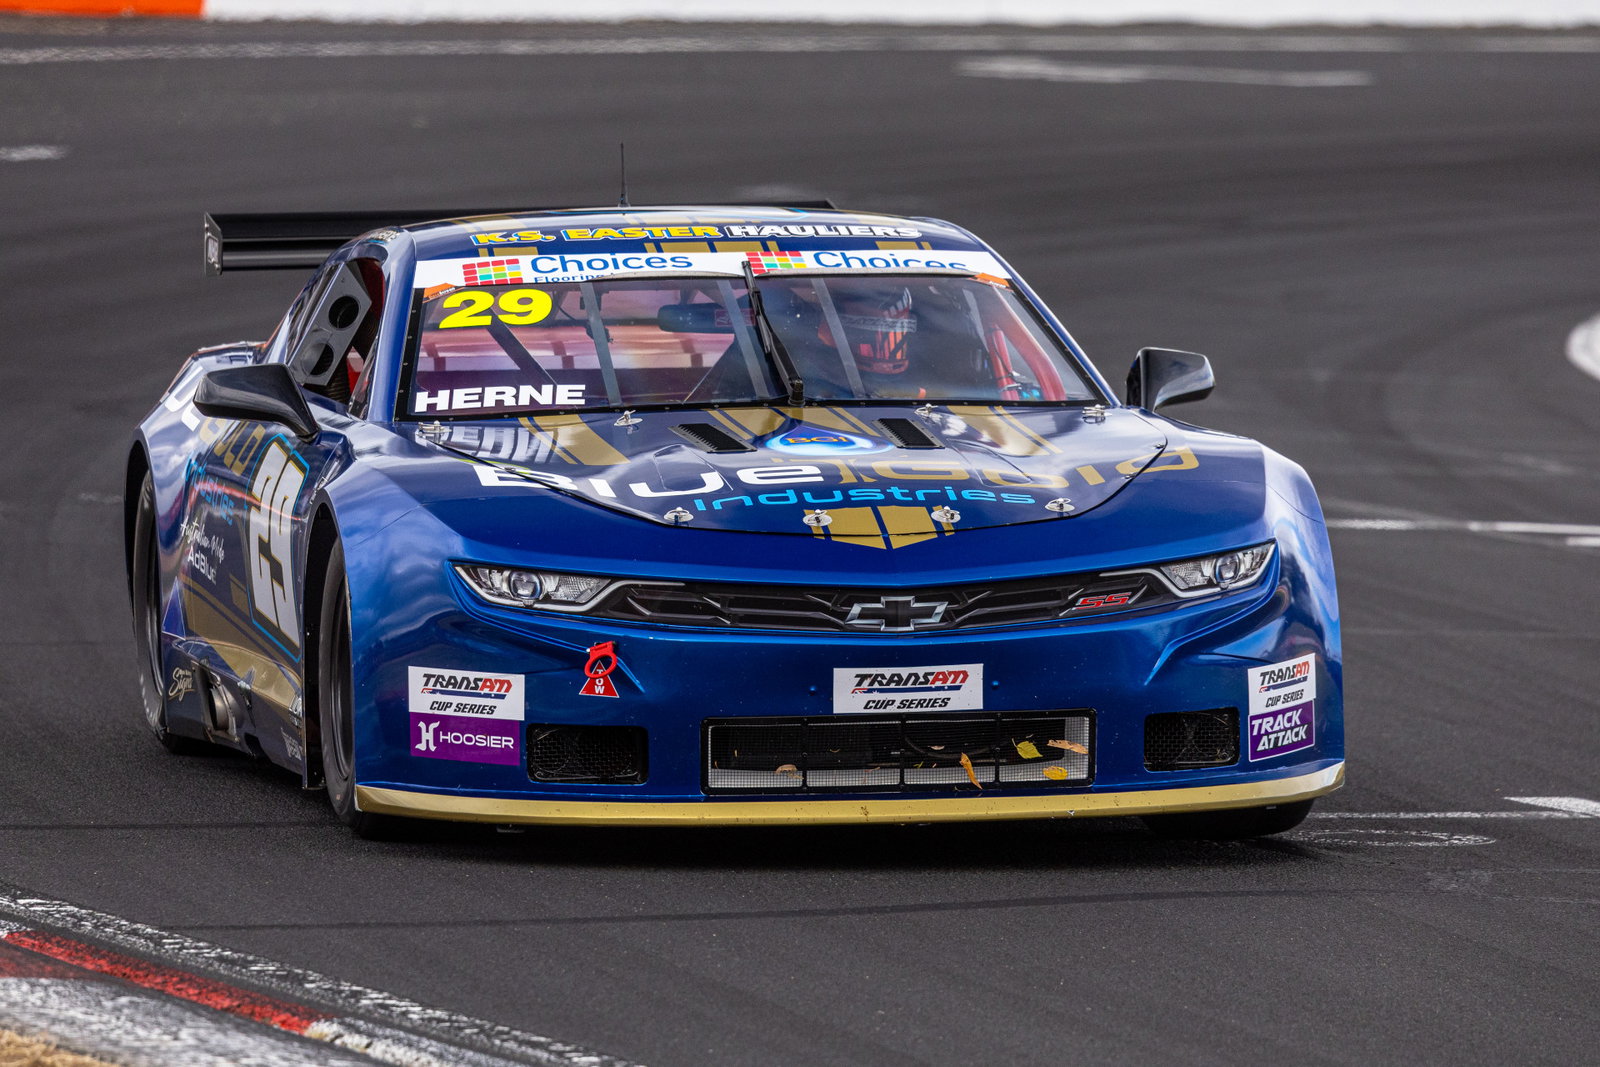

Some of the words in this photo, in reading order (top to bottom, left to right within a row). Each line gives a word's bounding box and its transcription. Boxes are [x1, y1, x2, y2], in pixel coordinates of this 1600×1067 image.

[469, 231, 556, 245] K.S.
[562, 226, 723, 241] EASTER
[726, 225, 922, 238] HAULIERS
[531, 252, 693, 274] Choices
[439, 288, 553, 328] 29
[414, 384, 586, 412] HERNE
[1071, 592, 1132, 611] SS
[594, 669, 605, 694] TOW
[430, 700, 452, 714] CUP
[453, 702, 497, 715] SERIES
[863, 700, 896, 710] CUP
[896, 697, 951, 710] SERIES
[1265, 695, 1281, 708] CUP
[1281, 689, 1304, 705] SERIES
[1251, 708, 1302, 736] TRACK
[439, 731, 514, 750] HOOSIER
[1256, 724, 1308, 751] ATTACK
